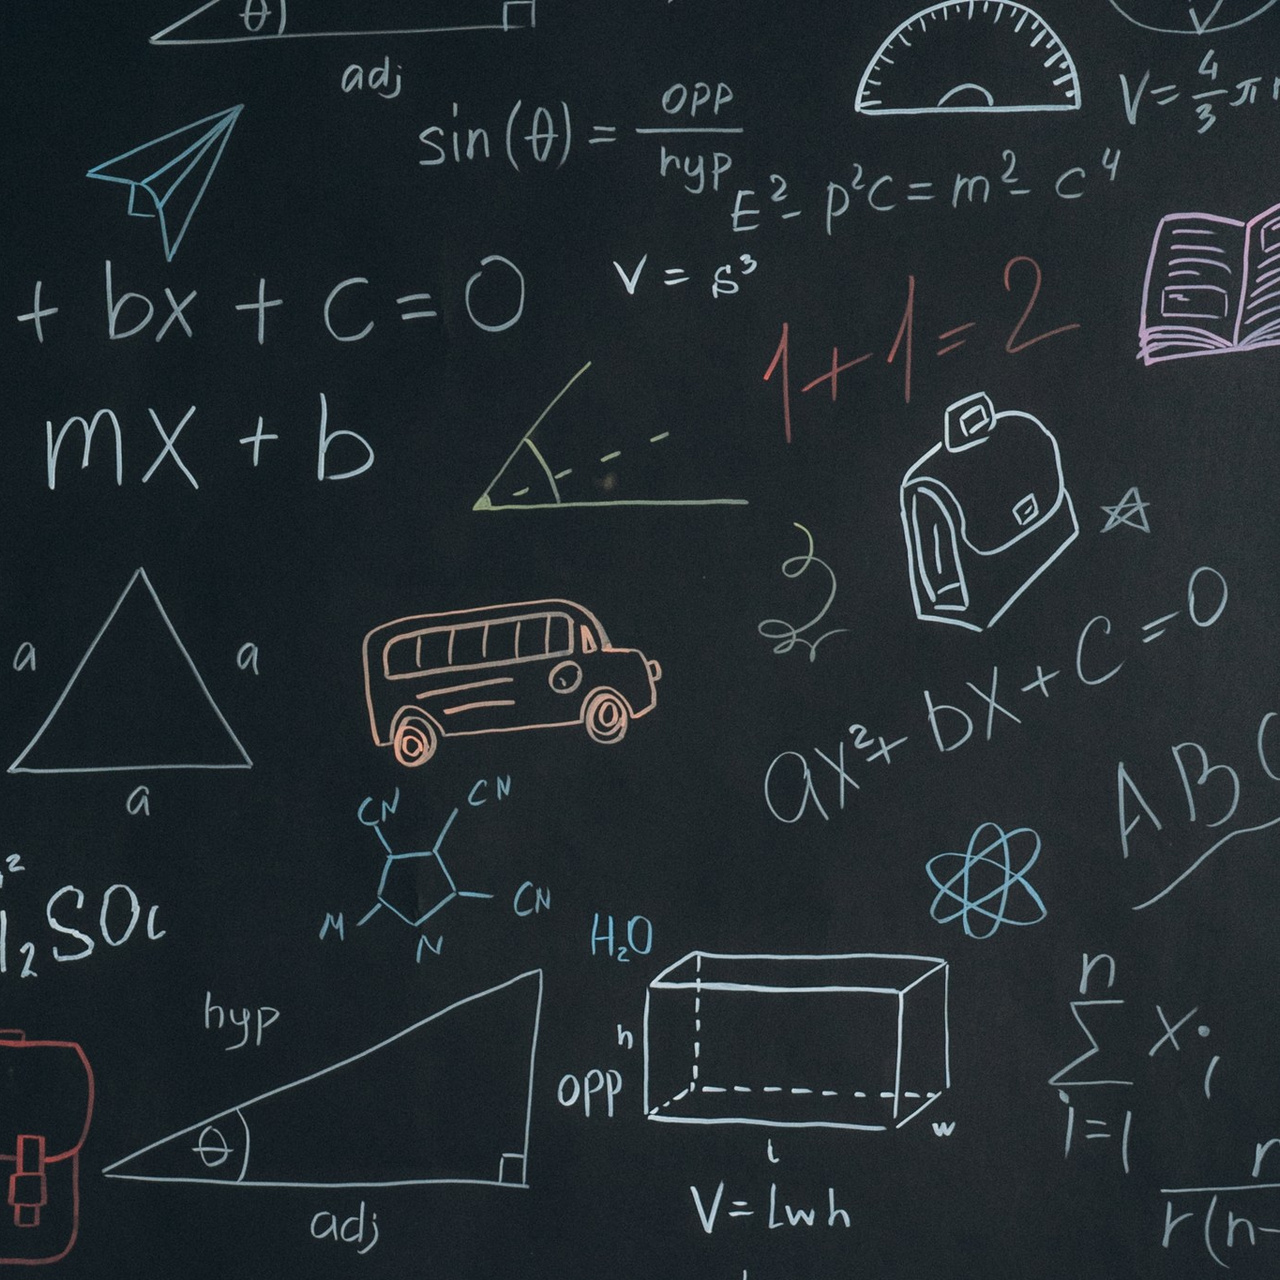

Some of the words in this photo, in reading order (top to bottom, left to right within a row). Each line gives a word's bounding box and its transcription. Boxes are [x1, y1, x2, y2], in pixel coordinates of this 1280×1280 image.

[340, 55, 402, 100] adj
[659, 145, 733, 195] hyp
[316, 391, 376, 482] b
[12, 641, 37, 672] a
[235, 641, 260, 676] a
[125, 784, 151, 817] a
[356, 786, 401, 829] CN
[466, 774, 512, 807] CN
[512, 880, 552, 918] CN
[203, 990, 281, 1052] hyp
[309, 1200, 380, 1256] adj
